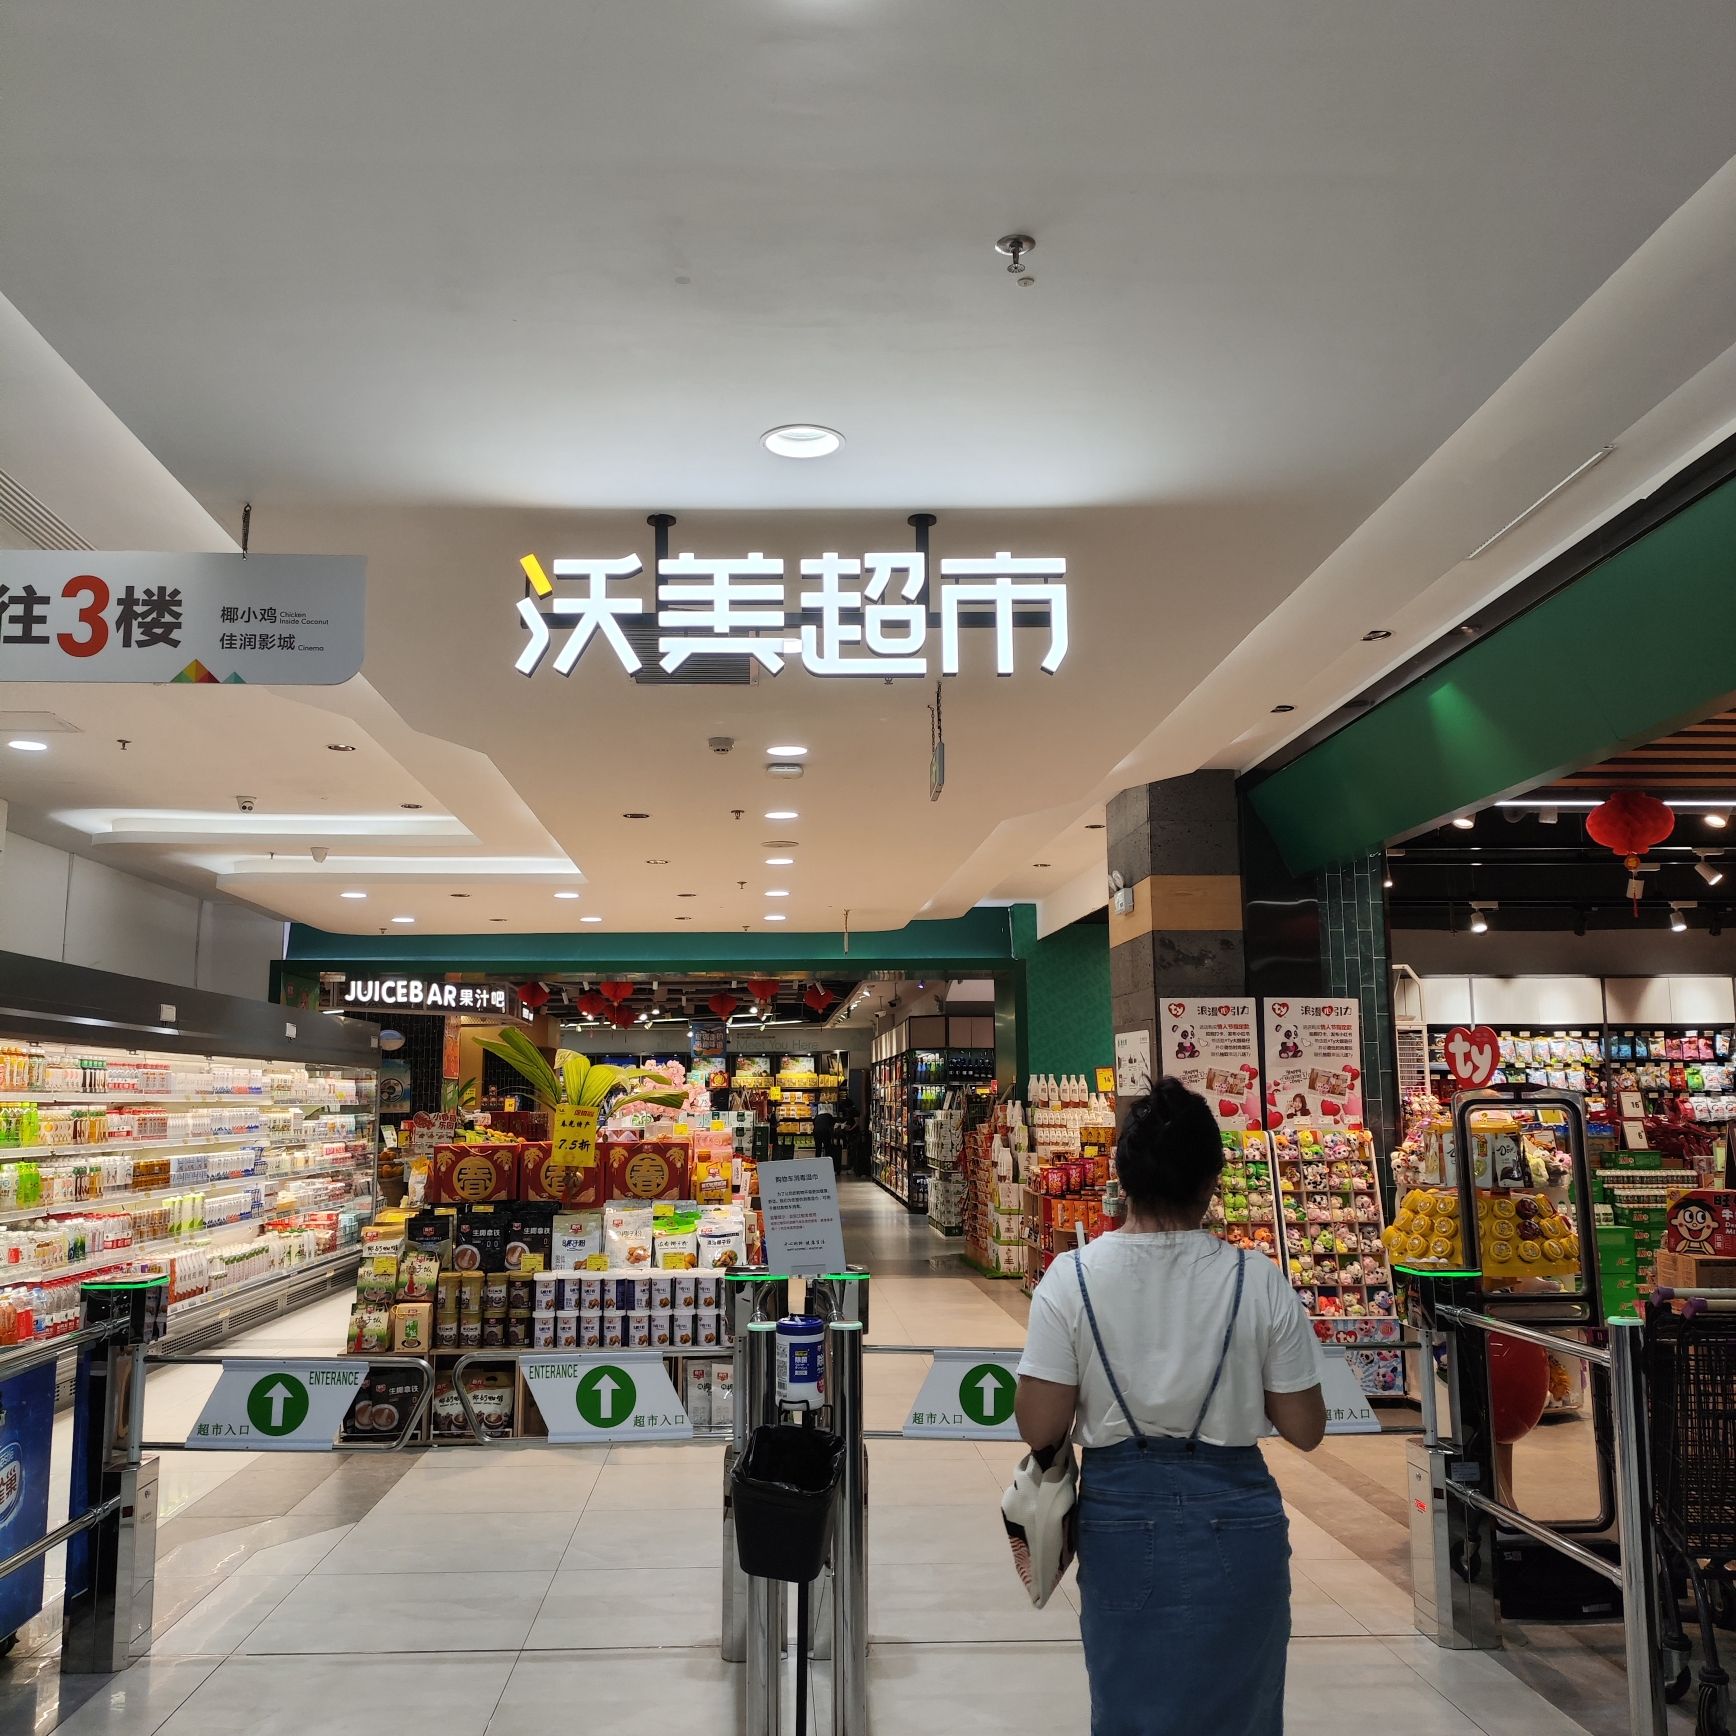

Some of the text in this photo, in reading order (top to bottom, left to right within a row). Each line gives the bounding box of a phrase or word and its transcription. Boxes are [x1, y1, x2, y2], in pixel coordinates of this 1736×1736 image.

[220, 606, 277, 623] 椰小鸡
[514, 551, 1068, 677] 沃美超市
[220, 632, 295, 650] 佳润影城
[344, 980, 505, 1008] JUICEBAR 果汁吧
[770, 1040, 788, 1050] You
[1448, 1033, 1492, 1084] ty
[558, 1139, 591, 1152] 7.5折
[308, 1370, 360, 1386] ENTERANCE
[528, 1364, 578, 1380] ENTERANCE
[633, 1414, 685, 1428] 超市入口
[912, 1411, 963, 1425] 超市入口
[196, 1423, 250, 1436] 超市入口
